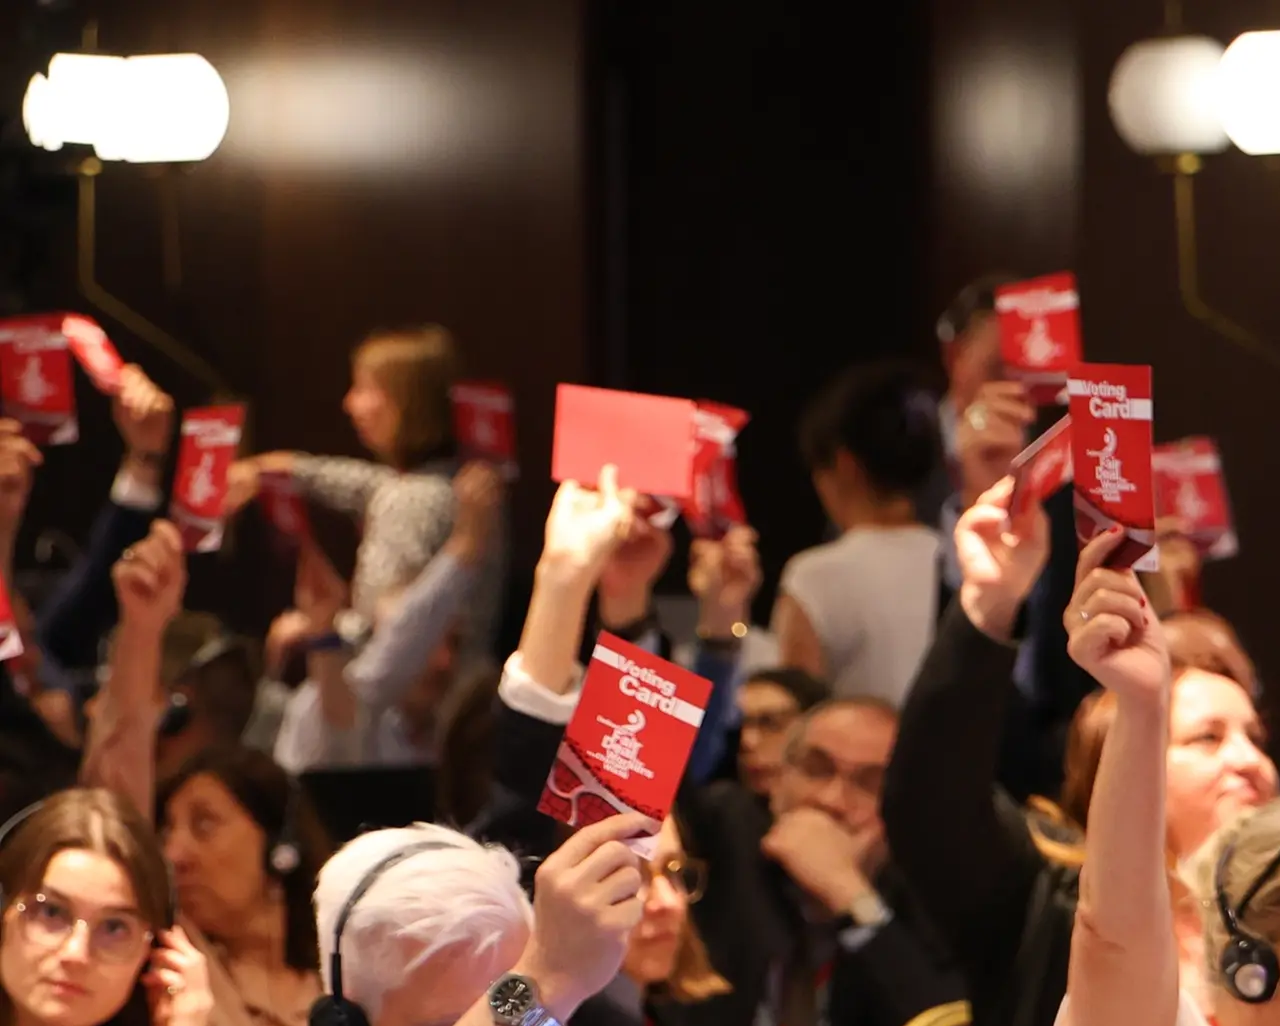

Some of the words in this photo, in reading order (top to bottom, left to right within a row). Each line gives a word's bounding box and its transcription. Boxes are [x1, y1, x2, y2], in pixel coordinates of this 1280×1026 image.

[1082, 380, 1127, 400] Voting
[1088, 397, 1132, 419] Card
[617, 654, 677, 697] Voting
[618, 674, 678, 716] Card
